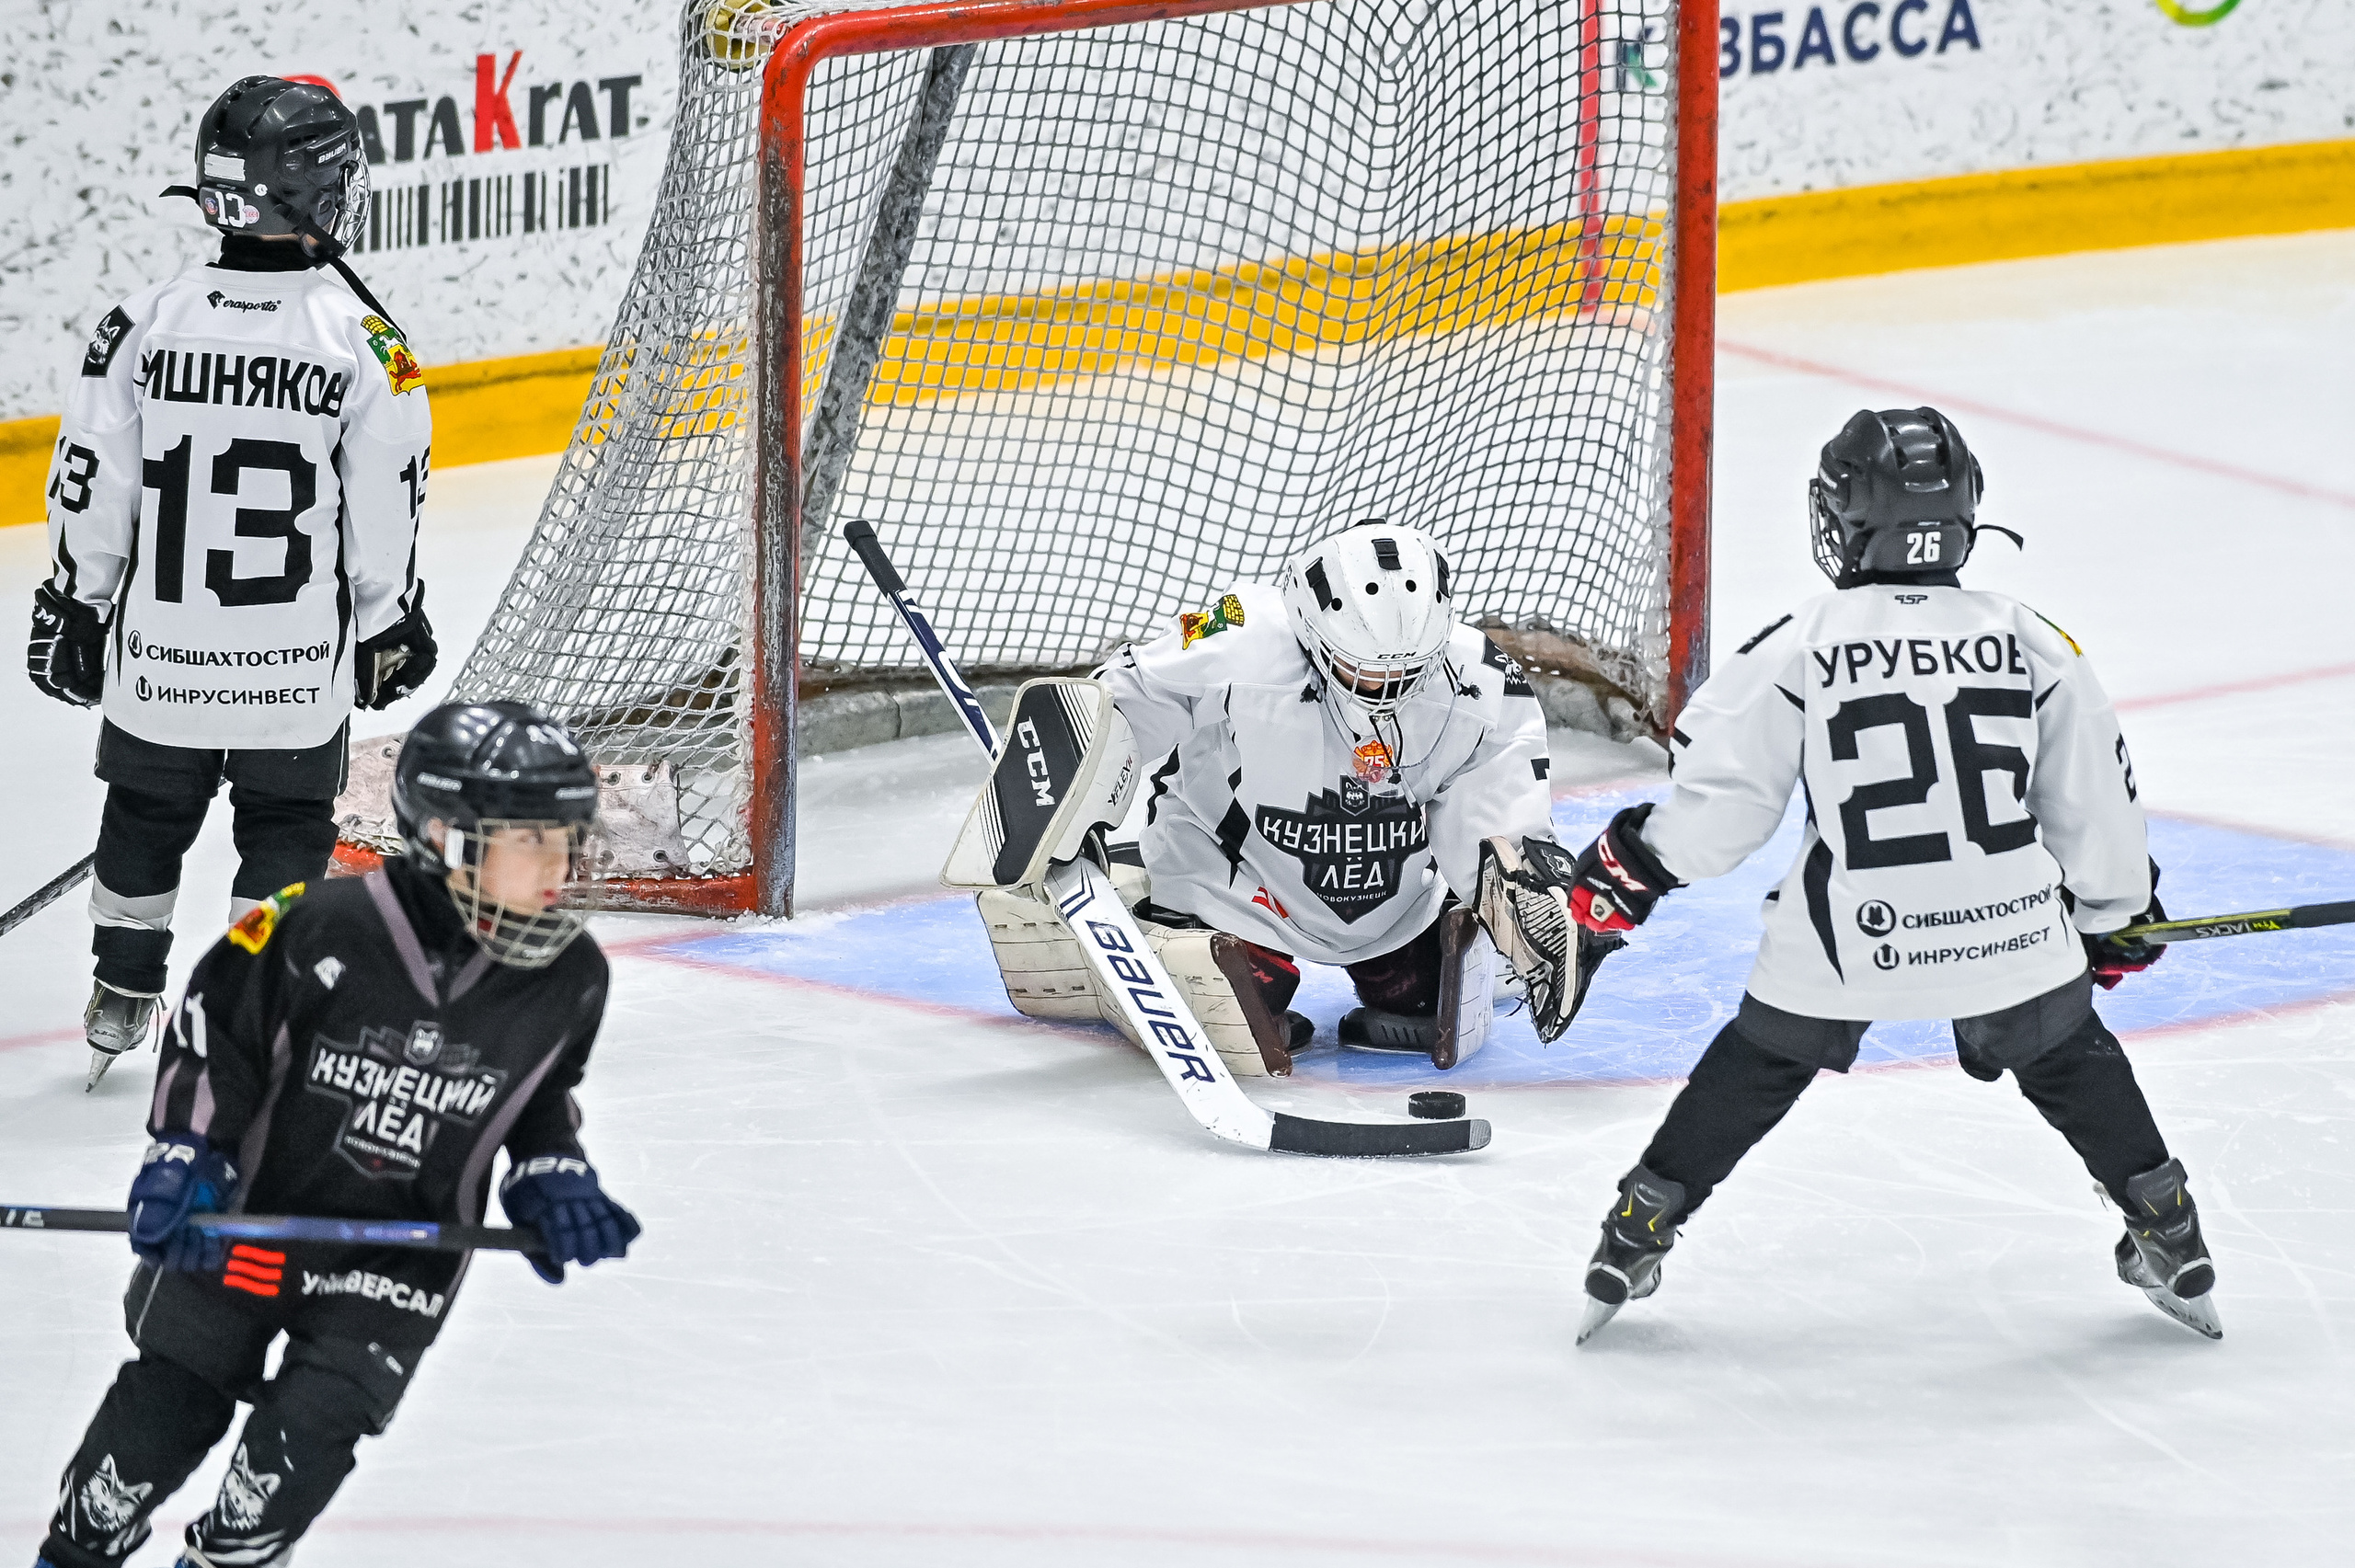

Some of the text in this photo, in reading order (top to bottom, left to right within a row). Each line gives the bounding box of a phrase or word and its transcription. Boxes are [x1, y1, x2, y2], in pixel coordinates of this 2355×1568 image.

[317, 143, 347, 164] BAUER
[214, 190, 247, 228] 13
[138, 349, 343, 418] ИШНЯКОВ
[142, 434, 316, 607] 13
[1906, 532, 1941, 565] 26
[145, 641, 330, 667] СИБШАХТОСТРОЙ
[1376, 651, 1418, 660] CCM
[156, 686, 320, 705] ИНРУСИНВЕСТ
[1017, 715, 1056, 807] CCM
[1826, 687, 2038, 871] 26
[1263, 816, 1426, 854] КУЗНЕЦКИ
[1320, 856, 1384, 890] ЛЁД
[1598, 832, 1649, 892] CM
[1907, 926, 2051, 966] ИНРУСИНВЕСТ
[1085, 920, 1216, 1083] BAUER
[311, 1047, 497, 1116] КУЗНЕЦКИЙ
[353, 1096, 425, 1155] ЛЁД
